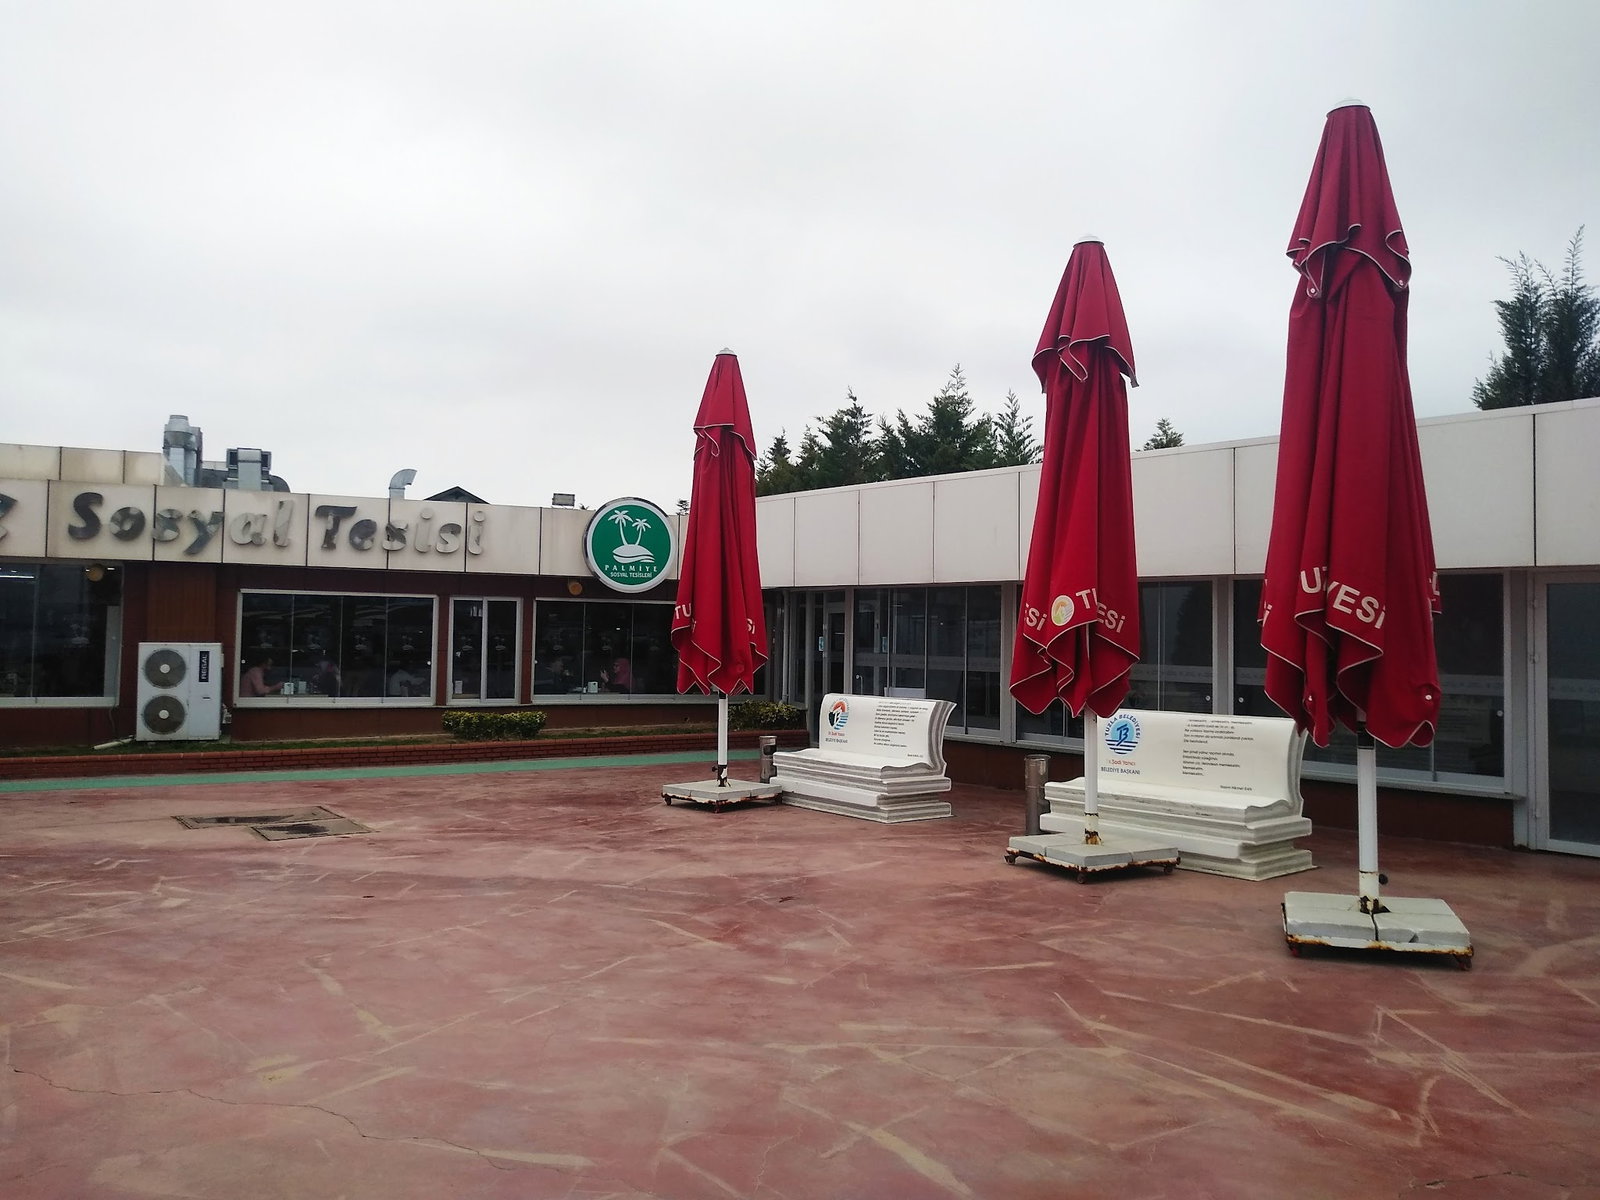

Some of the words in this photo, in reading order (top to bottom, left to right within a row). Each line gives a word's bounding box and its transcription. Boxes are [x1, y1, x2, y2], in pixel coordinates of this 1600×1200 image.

[68, 492, 295, 556] Sosyal
[315, 505, 487, 555] Tesisi
[1104, 716, 1118, 737] TUZLA
